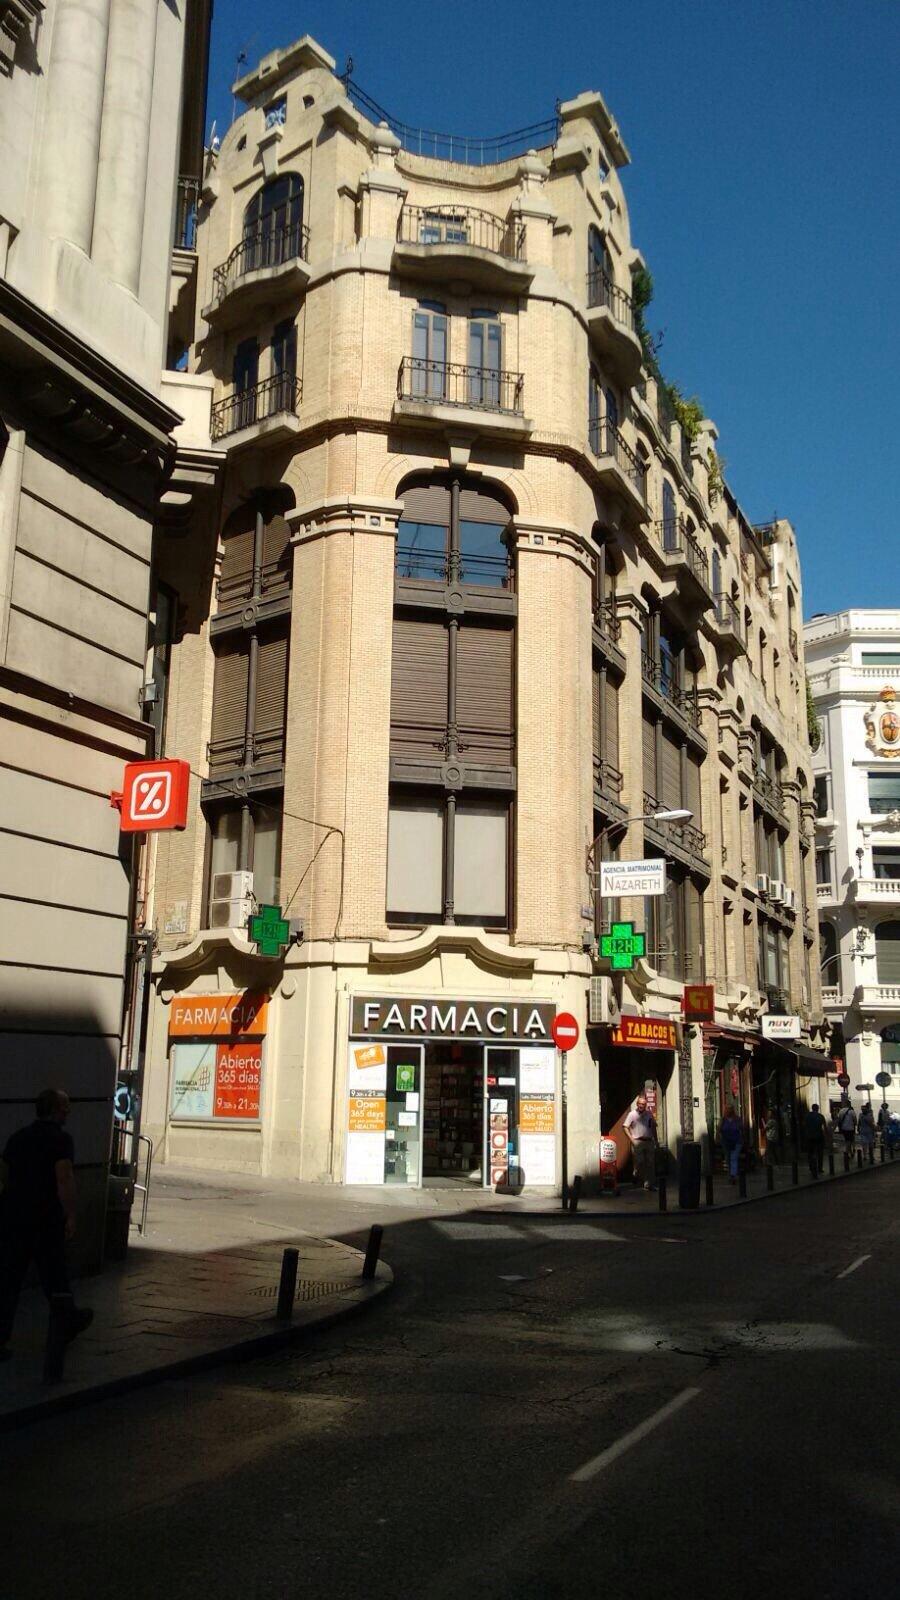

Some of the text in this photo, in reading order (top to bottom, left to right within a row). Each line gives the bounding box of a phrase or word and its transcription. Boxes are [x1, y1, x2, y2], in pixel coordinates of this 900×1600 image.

[603, 864, 662, 874] AGENCIA MATRIMONIAL
[604, 875, 661, 892] NAZARETH
[174, 1006, 258, 1025] FARMACIA
[364, 1003, 547, 1034] FARMACIA
[626, 1022, 668, 1039] TABACOS
[219, 1054, 262, 1070] Abierto
[217, 1069, 236, 1083] 365
[356, 1100, 379, 1109] Open
[523, 1104, 553, 1112] Abierto
[350, 1109, 384, 1120] 365 days
[523, 1112, 535, 1120] 365
